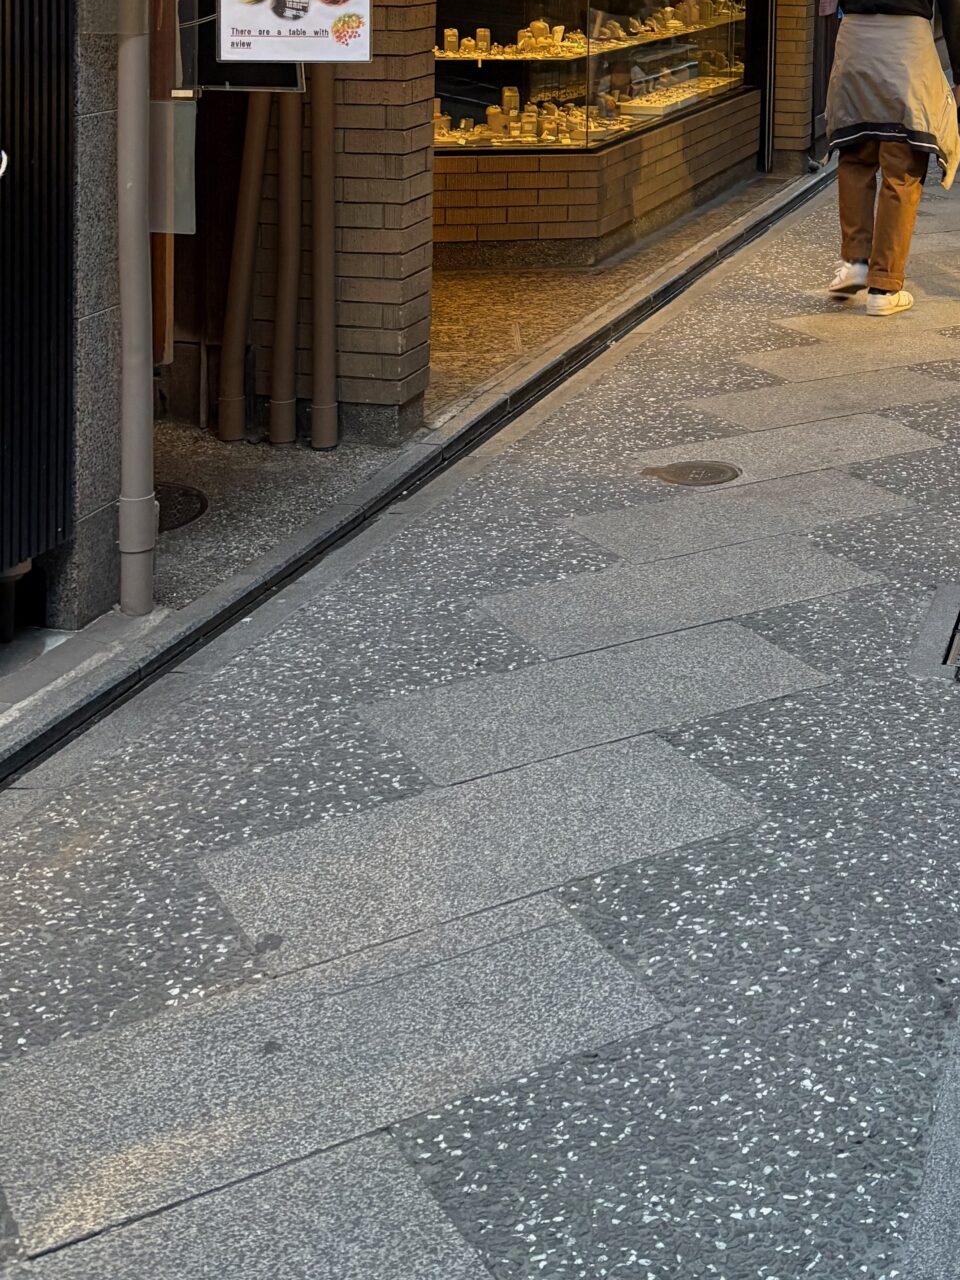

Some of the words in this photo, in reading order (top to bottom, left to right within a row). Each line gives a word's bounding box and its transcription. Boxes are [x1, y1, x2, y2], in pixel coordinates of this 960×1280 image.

[231, 27, 252, 36] There
[258, 28, 270, 36] are
[288, 27, 307, 36] table
[313, 27, 329, 36] with
[230, 39, 252, 48] aview
